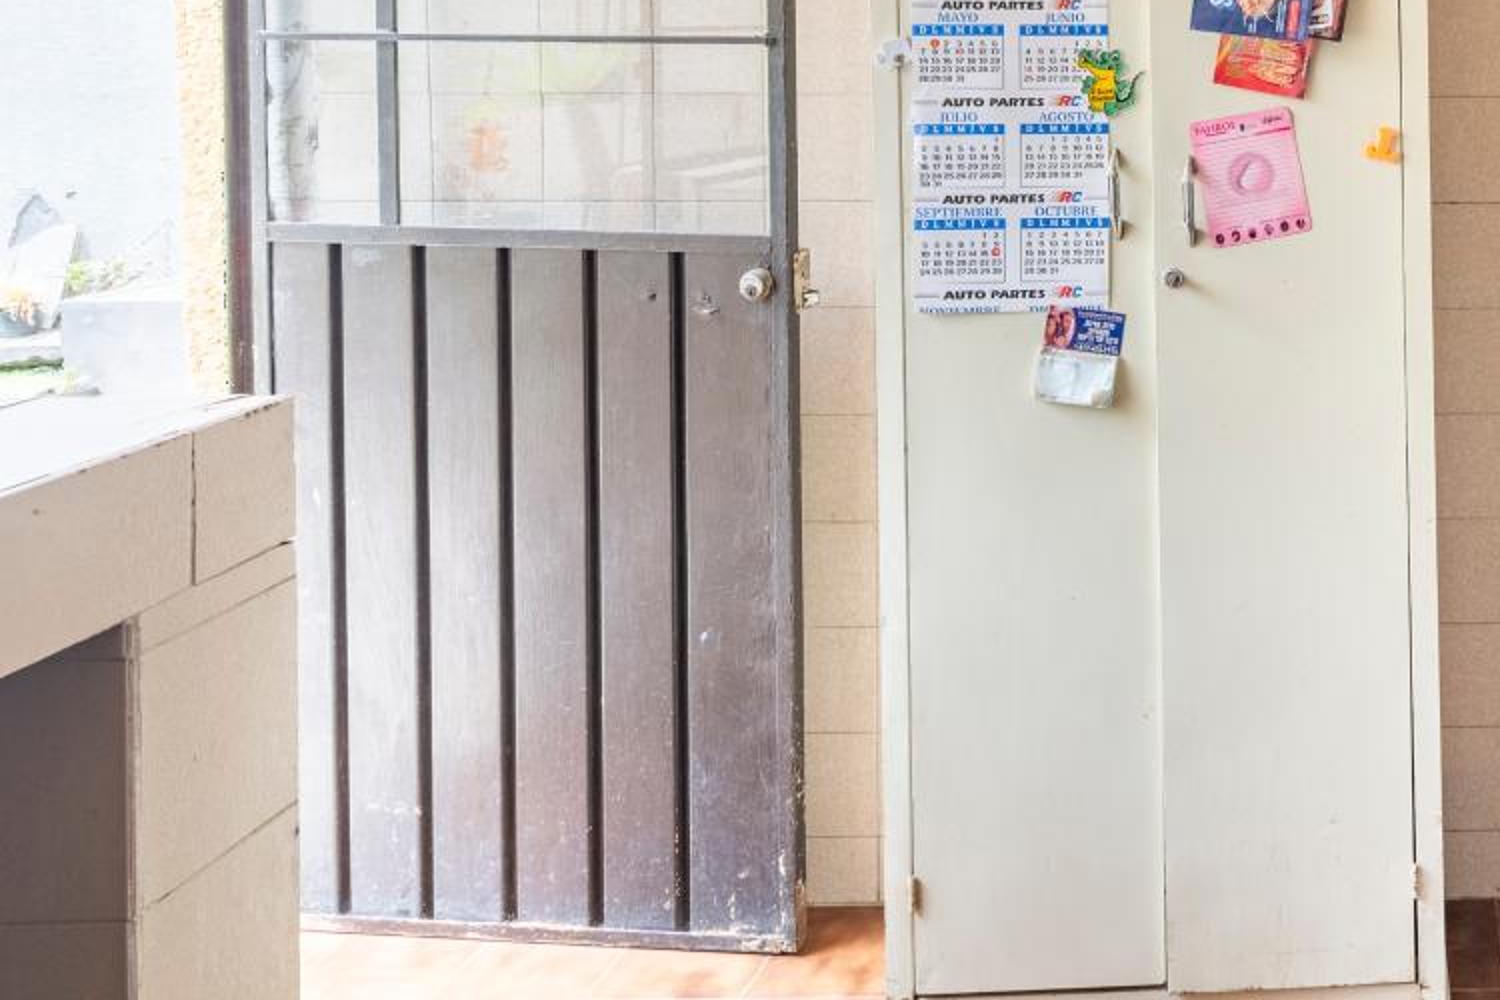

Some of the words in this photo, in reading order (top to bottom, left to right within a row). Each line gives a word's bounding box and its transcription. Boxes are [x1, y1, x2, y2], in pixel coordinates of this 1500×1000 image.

[941, 2, 984, 10] AUTO
[989, 1, 1044, 10] PARTES
[938, 13, 979, 23] MAYO
[1045, 13, 1085, 24] JUNIO
[942, 97, 985, 106] AUTO
[989, 97, 1044, 106] PARTES
[1057, 95, 1082, 106] RC
[940, 112, 978, 122] JULIO
[1040, 111, 1094, 122] AGOSTO
[943, 195, 985, 204] AUTO
[990, 194, 1045, 203] PARTES
[1058, 191, 1082, 202] RC
[916, 206, 1003, 217] SEPTIEMBRE
[1035, 206, 1097, 216] OCTUBRE
[944, 290, 986, 299] AUTO
[991, 289, 1046, 299] PARTES
[1058, 285, 1083, 297] RC
